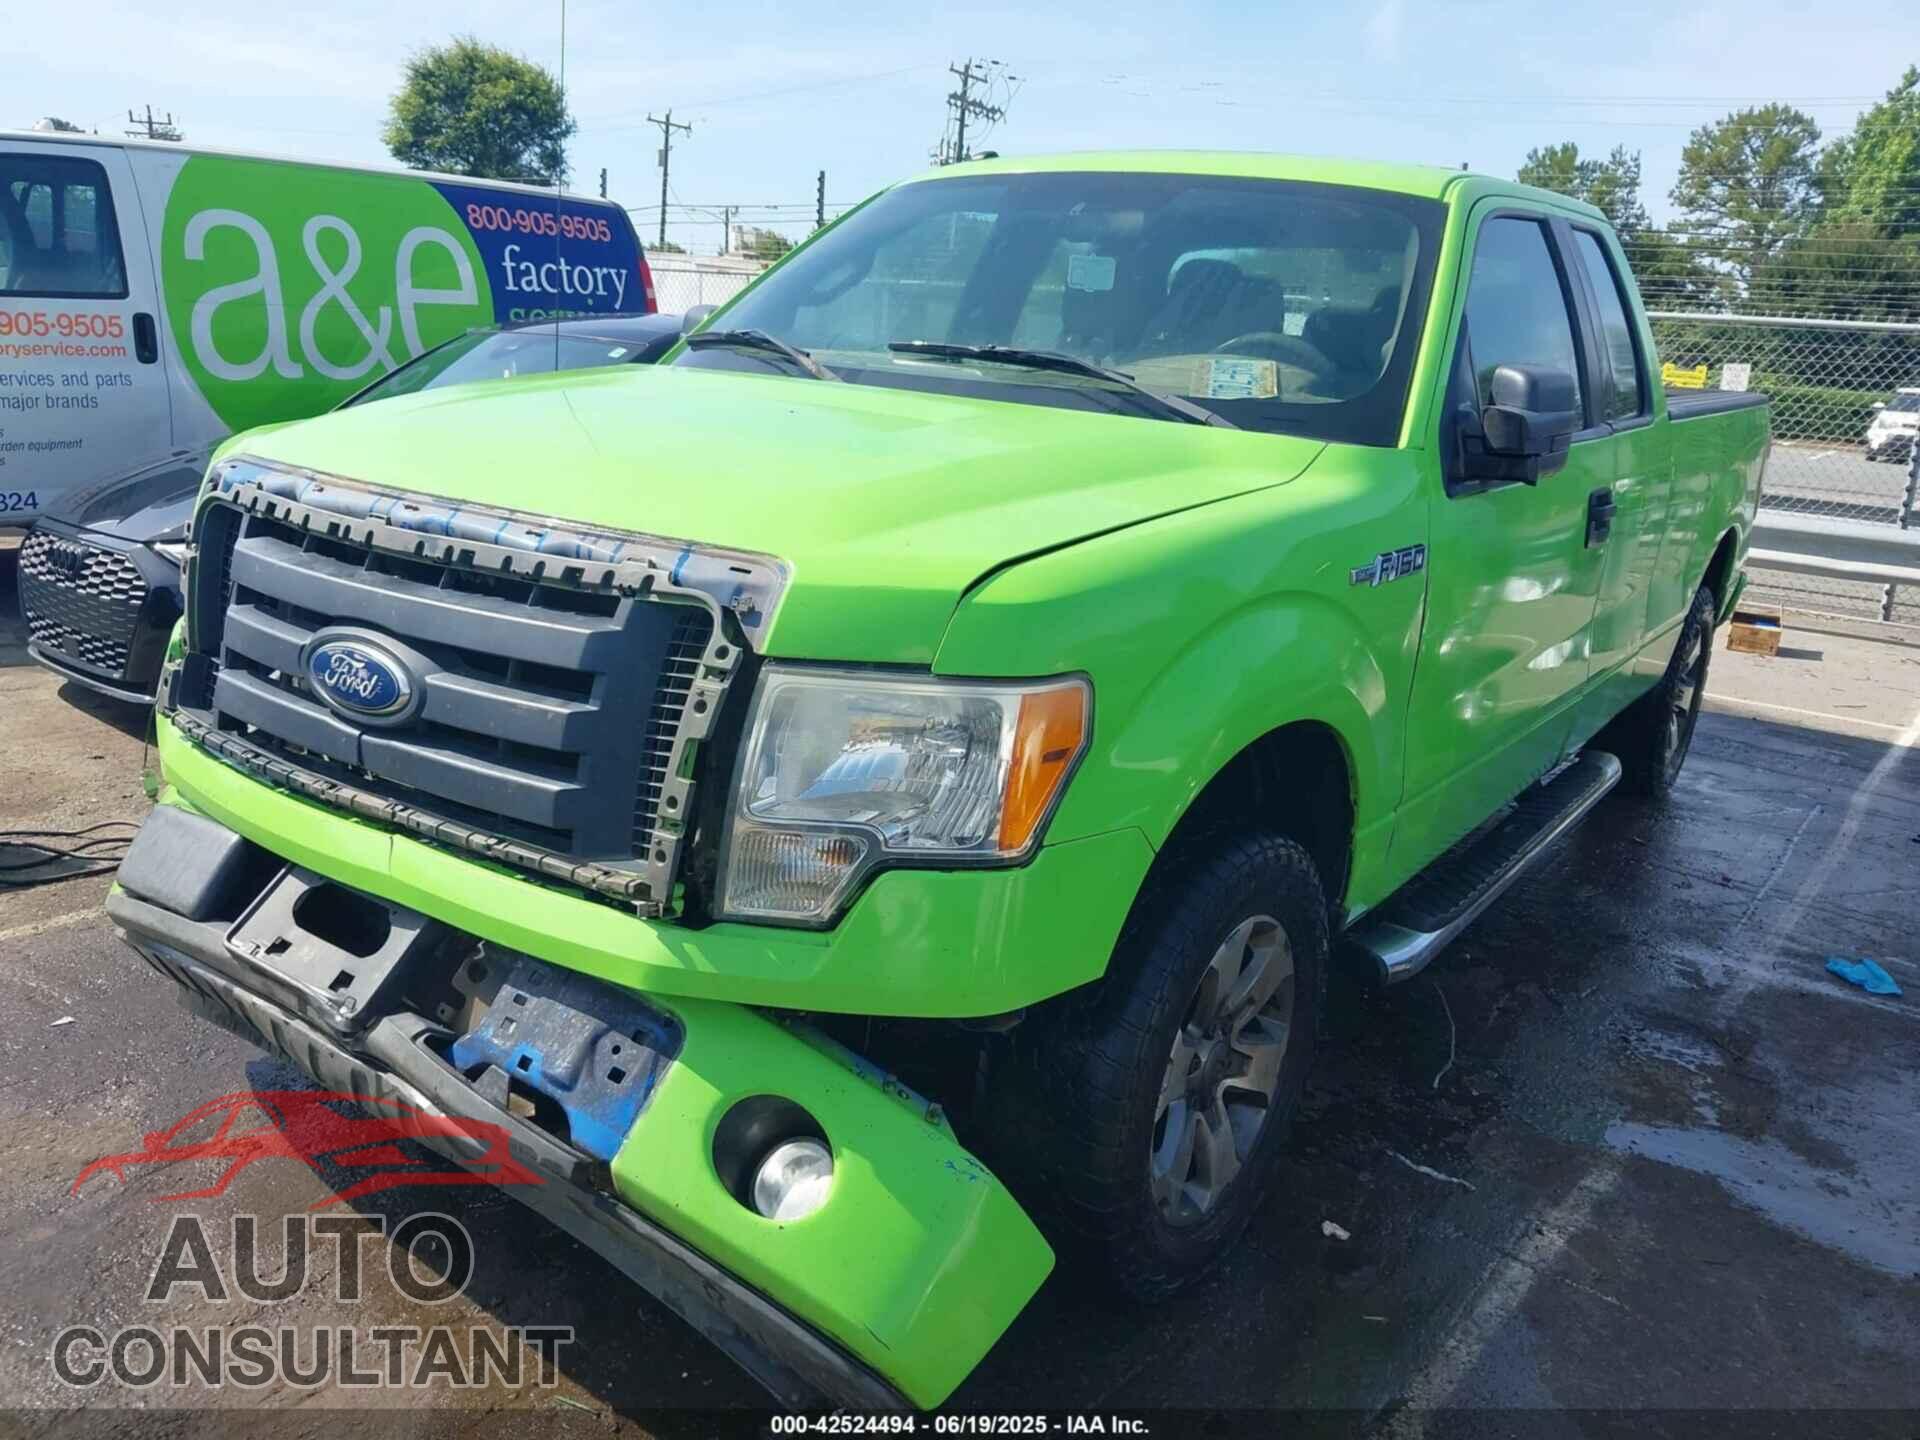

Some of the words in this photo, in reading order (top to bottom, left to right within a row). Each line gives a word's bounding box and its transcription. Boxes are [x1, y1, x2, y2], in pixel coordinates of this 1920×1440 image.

[502, 245, 628, 309] factory
[184, 208, 479, 381] a&e
[61, 371, 88, 387] and
[96, 371, 132, 389] parts
[45, 393, 98, 409] brands
[28, 438, 83, 452] equipment
[324, 653, 381, 699] Ford
